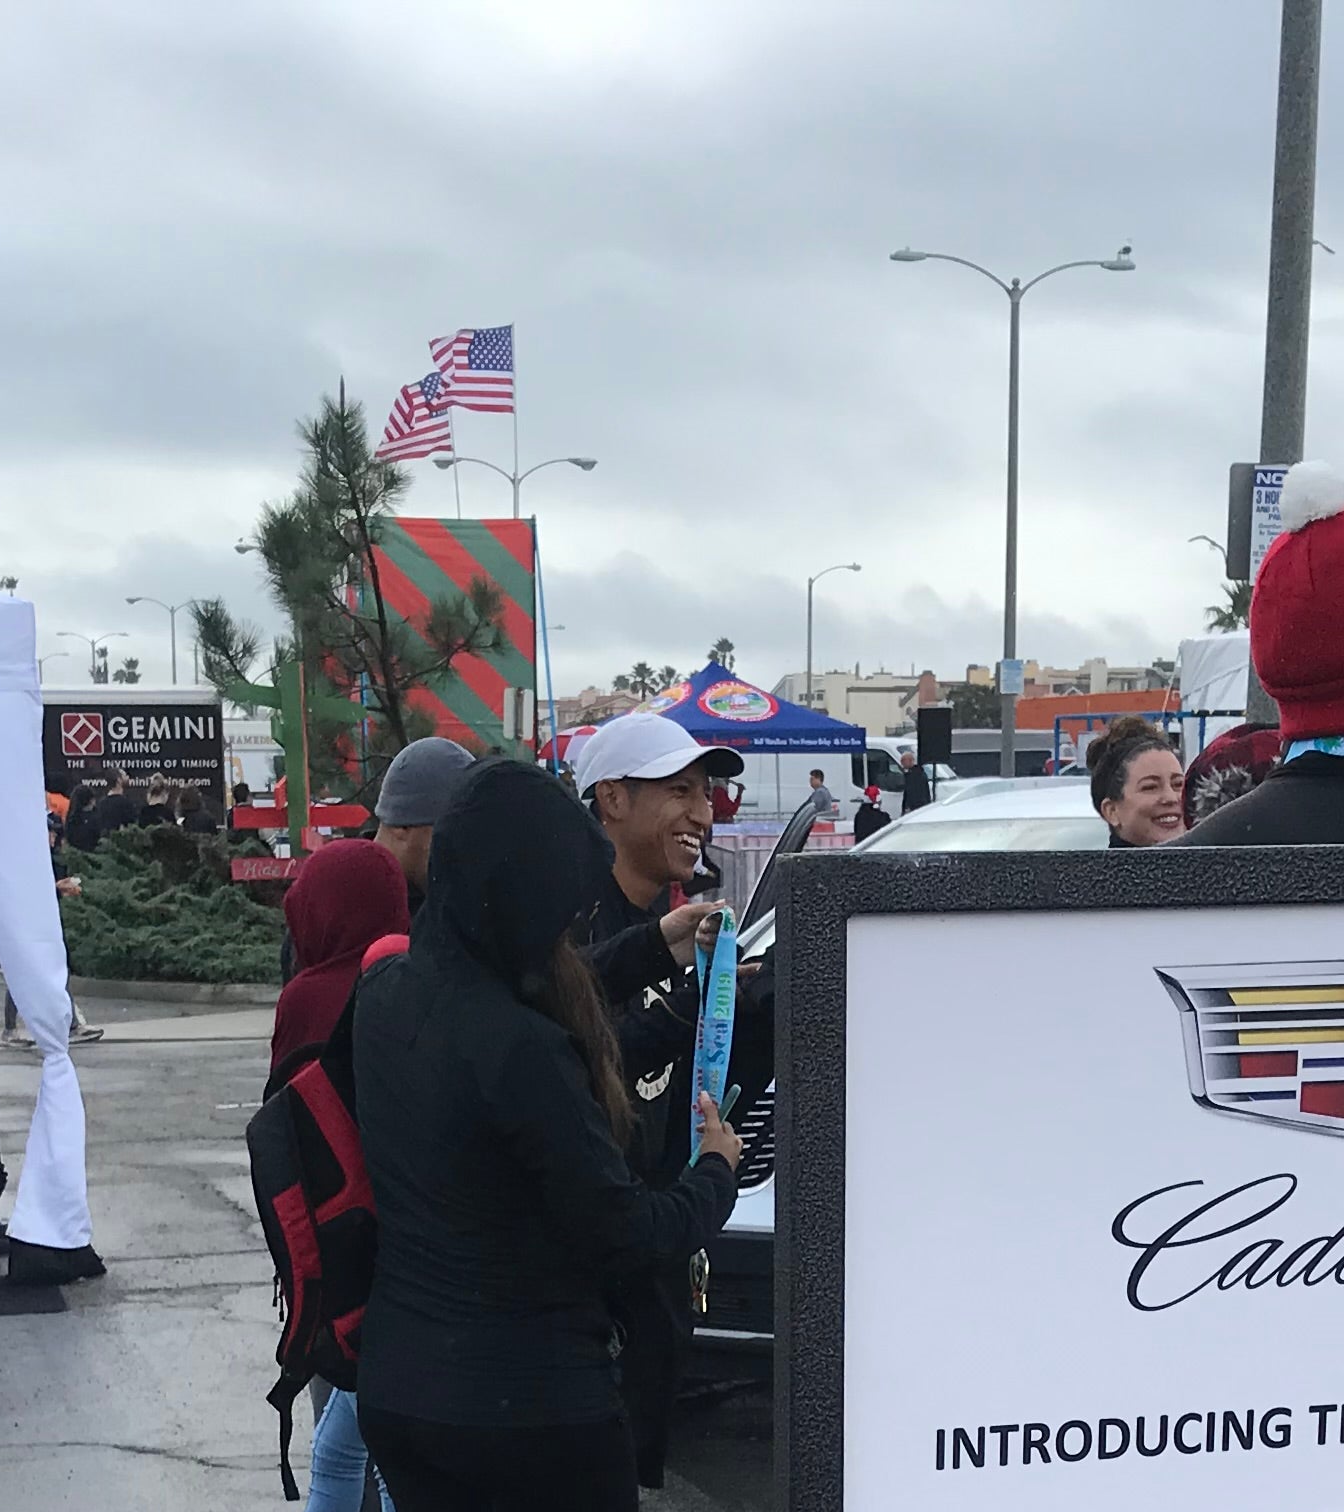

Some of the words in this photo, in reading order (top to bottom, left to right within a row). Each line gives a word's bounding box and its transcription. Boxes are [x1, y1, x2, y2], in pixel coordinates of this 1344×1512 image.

[107, 716, 215, 740] GEMINI
[110, 741, 160, 754] TIMING
[67, 760, 85, 769] THE
[164, 760, 178, 769] OF
[181, 759, 219, 769] TIMING
[714, 972, 732, 1019] 2019
[936, 1408, 1292, 1471] INTRODUCING
